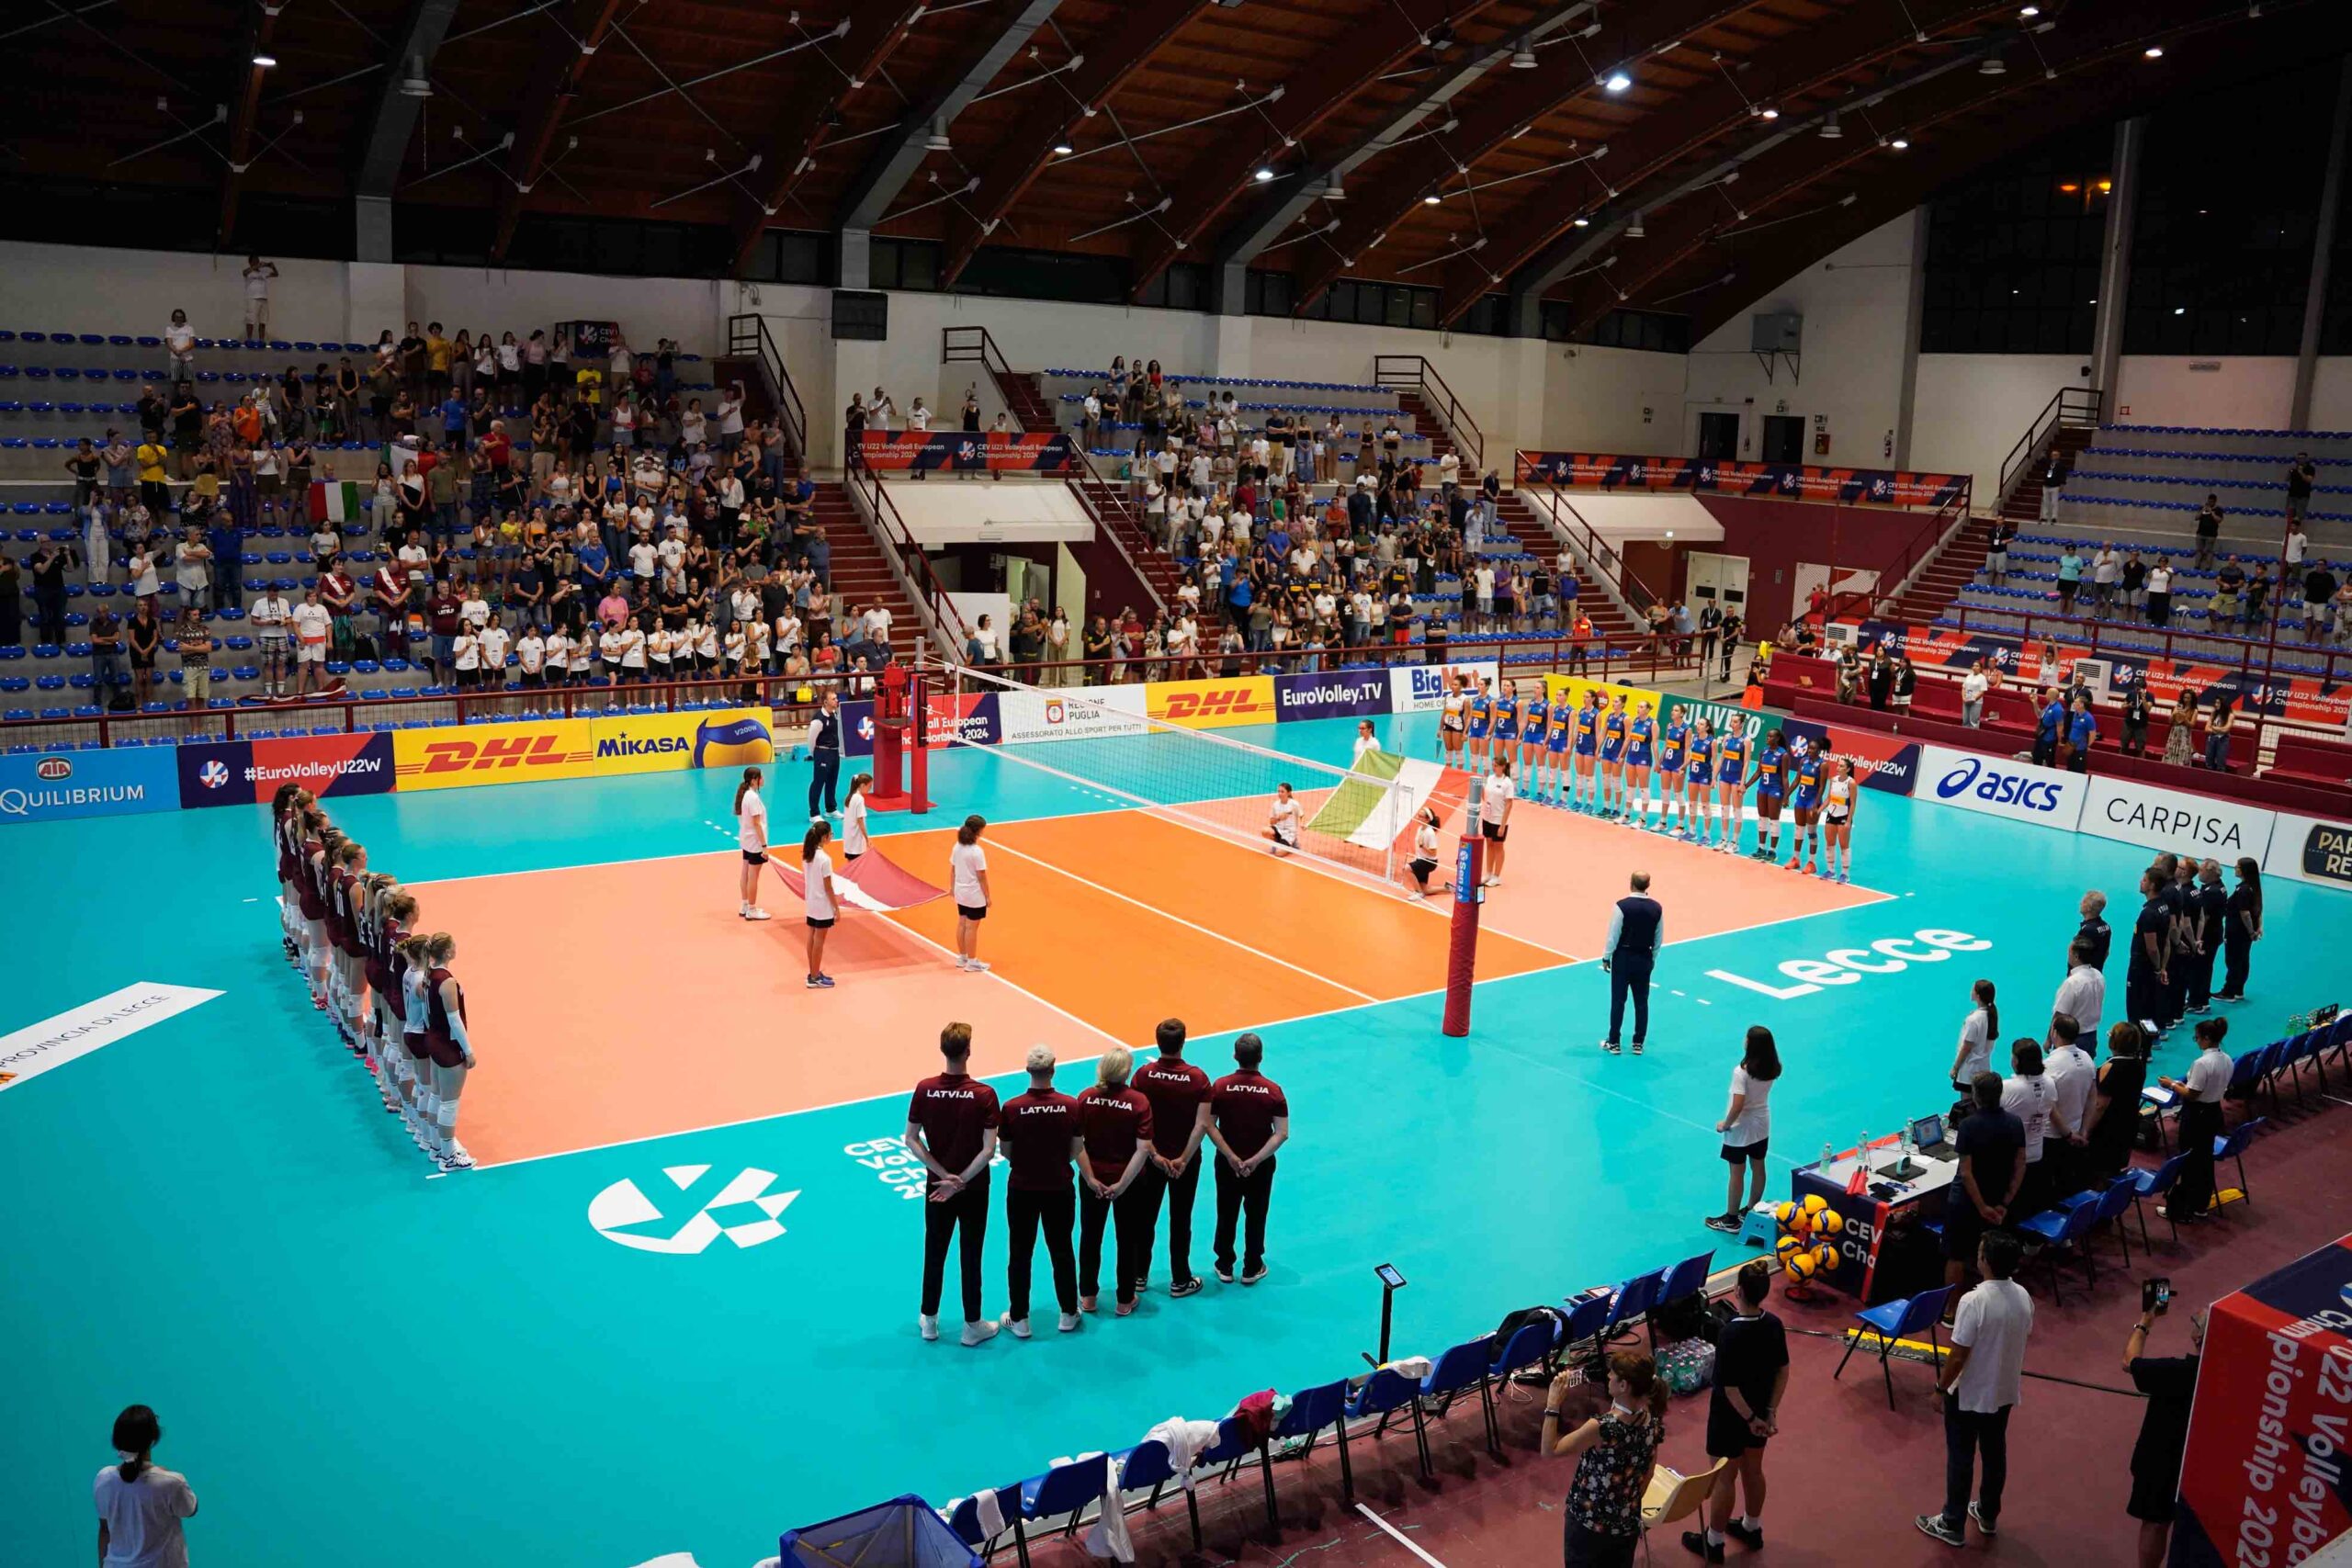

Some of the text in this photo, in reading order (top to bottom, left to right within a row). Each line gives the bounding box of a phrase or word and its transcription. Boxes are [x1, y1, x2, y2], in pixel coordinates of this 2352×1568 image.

[853, 451, 899, 459] Campionship
[1896, 643, 1937, 655] Championship
[1923, 638, 1951, 648] Volleyball
[1951, 643, 1980, 652] European
[2009, 659, 2041, 670] Champion
[2133, 676, 2184, 691] Cmpionship
[2151, 671, 2165, 679] U22
[2166, 673, 2201, 684] Volleyball
[2202, 678, 2237, 690] European
[1283, 682, 1382, 707] EuroVolley.TV
[2277, 689, 2350, 705] CEV U22 Volleyball
[1165, 689, 1260, 718] DHL
[1414, 701, 1433, 709] HOME
[2275, 698, 2348, 715] Championship 202
[1069, 711, 1100, 720] PUGLIA
[735, 724, 757, 735] V200W
[1473, 718, 1479, 728] 8
[965, 728, 989, 739] 2024
[1012, 729, 1064, 739] ASSESSORATO
[1084, 726, 1106, 734] SPORT
[1607, 739, 1615, 749] 17
[424, 735, 568, 773] DHL
[244, 758, 381, 782] #EuroVolleyU22W
[1691, 761, 1700, 773] 16
[1764, 773, 1770, 784] 9
[1800, 784, 1805, 797] 2
[1976, 772, 2064, 812] asics
[0, 784, 144, 816] QUILIBRIUM
[2106, 797, 2242, 850] CARPISA
[1703, 929, 1993, 999] Lecce
[0, 994, 171, 1067] PROVINCIA DI LECCE
[1148, 1071, 1191, 1082] LATVIJA
[926, 1089, 975, 1099] LATVIJA
[1226, 1085, 1269, 1095] LATVIJA
[1020, 1105, 1067, 1115] LATVIJA
[1086, 1097, 1133, 1111] LATVIJA
[1845, 1218, 1883, 1245] CEV
[2286, 1414, 2348, 1568] Volleyba
[2235, 1495, 2278, 1568] 202
